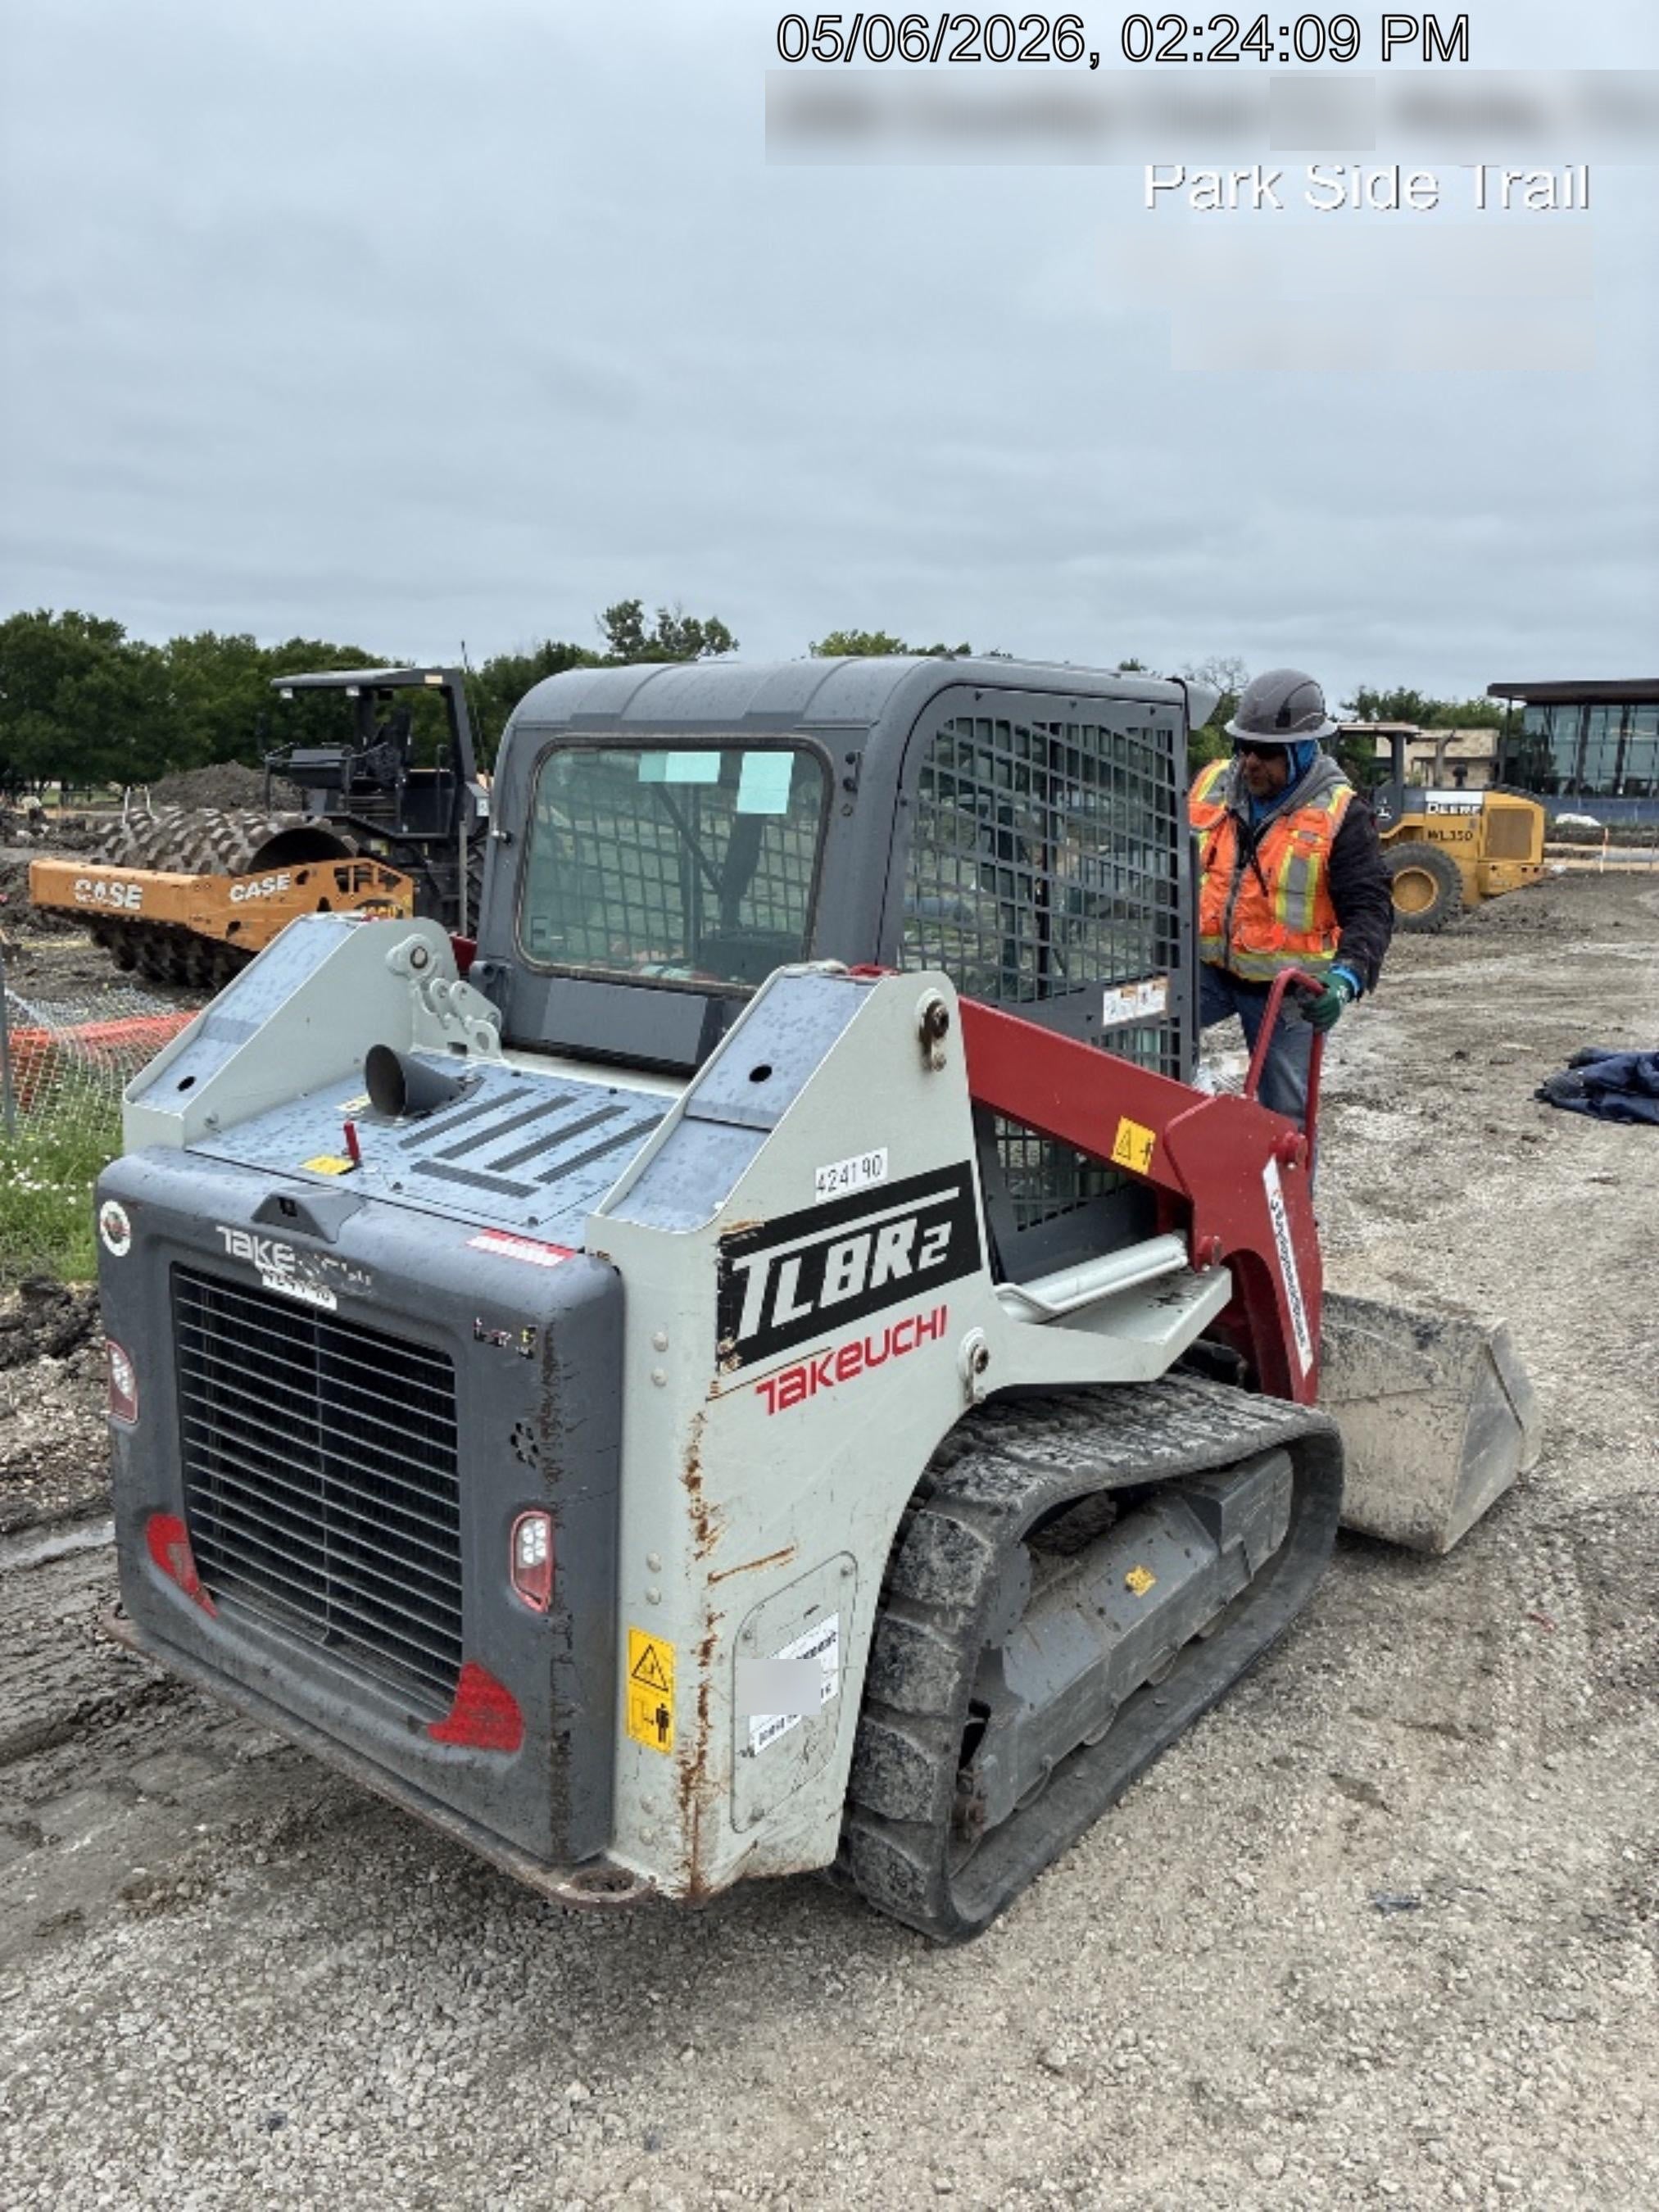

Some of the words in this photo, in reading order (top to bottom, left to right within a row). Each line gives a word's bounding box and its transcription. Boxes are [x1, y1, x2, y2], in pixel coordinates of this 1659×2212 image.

[74, 878, 143, 910] CASE
[229, 873, 291, 902] CASE
[817, 1154, 883, 1194] 424190
